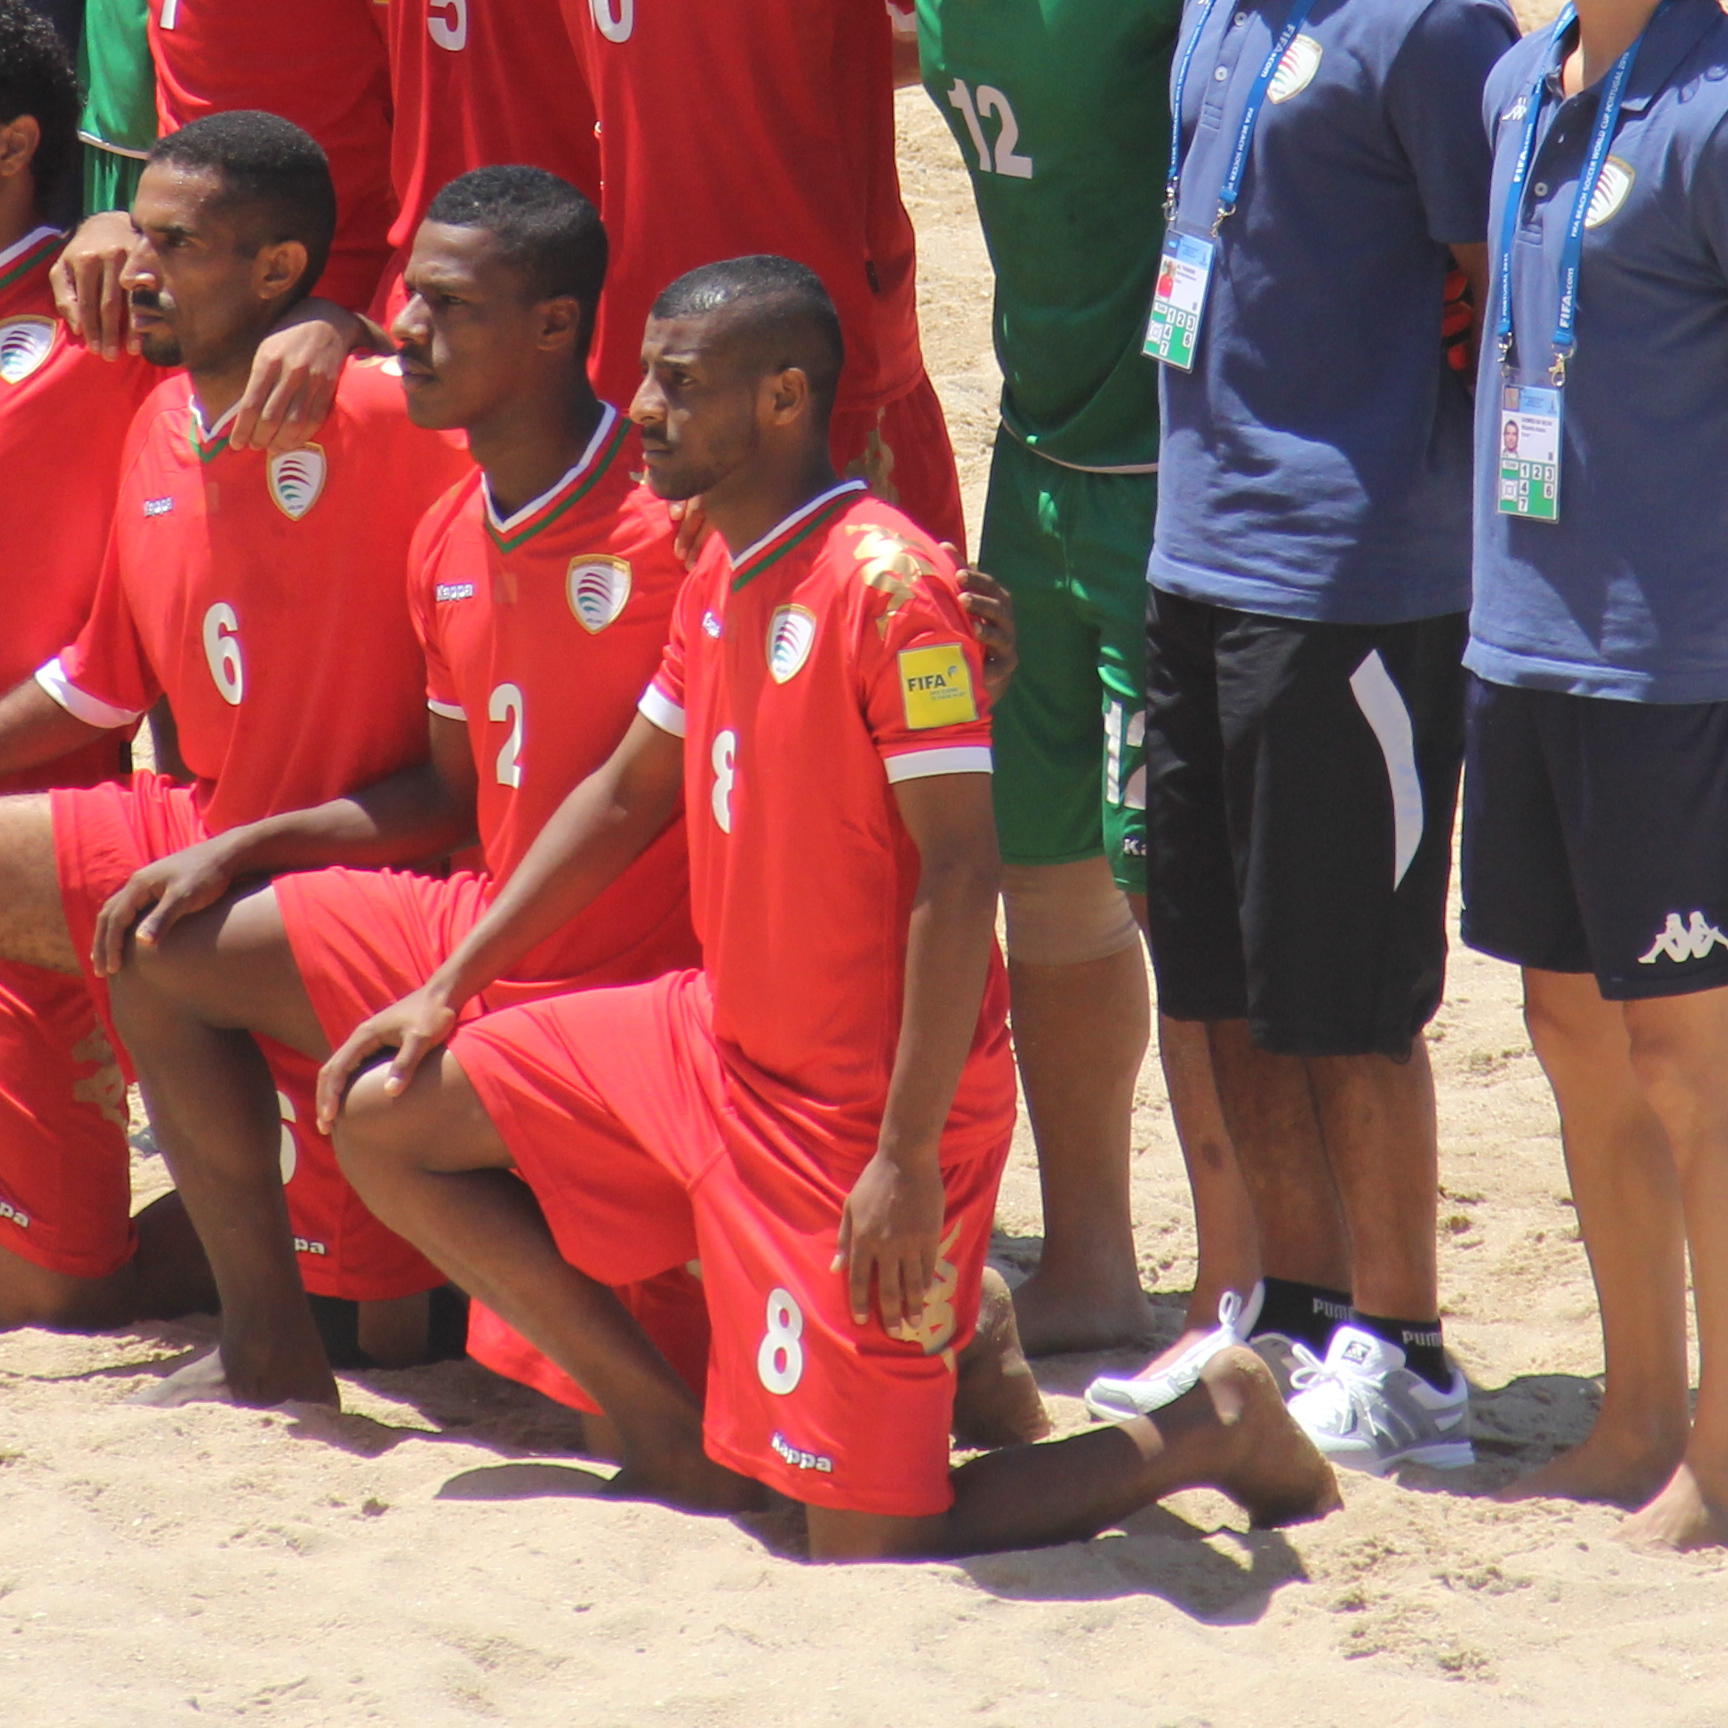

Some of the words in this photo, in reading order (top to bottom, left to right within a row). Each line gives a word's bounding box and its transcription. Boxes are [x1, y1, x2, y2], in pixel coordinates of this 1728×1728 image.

[1604, 71, 1623, 113] PORTUGAL
[947, 78, 1032, 179] 12
[1244, 107, 1254, 124] FIFA
[1600, 112, 1610, 130] CUP
[1237, 124, 1249, 151] BEACH
[1591, 130, 1606, 160] WORLD
[1229, 151, 1241, 181] SOCCER
[1582, 160, 1596, 191] SOCCER
[1575, 192, 1587, 219] BEACH
[1570, 220, 1580, 237] FIFA
[1534, 466, 1540, 478] 2
[1546, 468, 1552, 481] 3
[1521, 482, 1527, 494] 4
[1546, 485, 1552, 497] 6
[203, 602, 243, 705] 6
[908, 674, 947, 692] FIFA
[489, 683, 524, 789] 2
[757, 1287, 804, 1395] 8
[771, 1431, 833, 1474] Kappa
